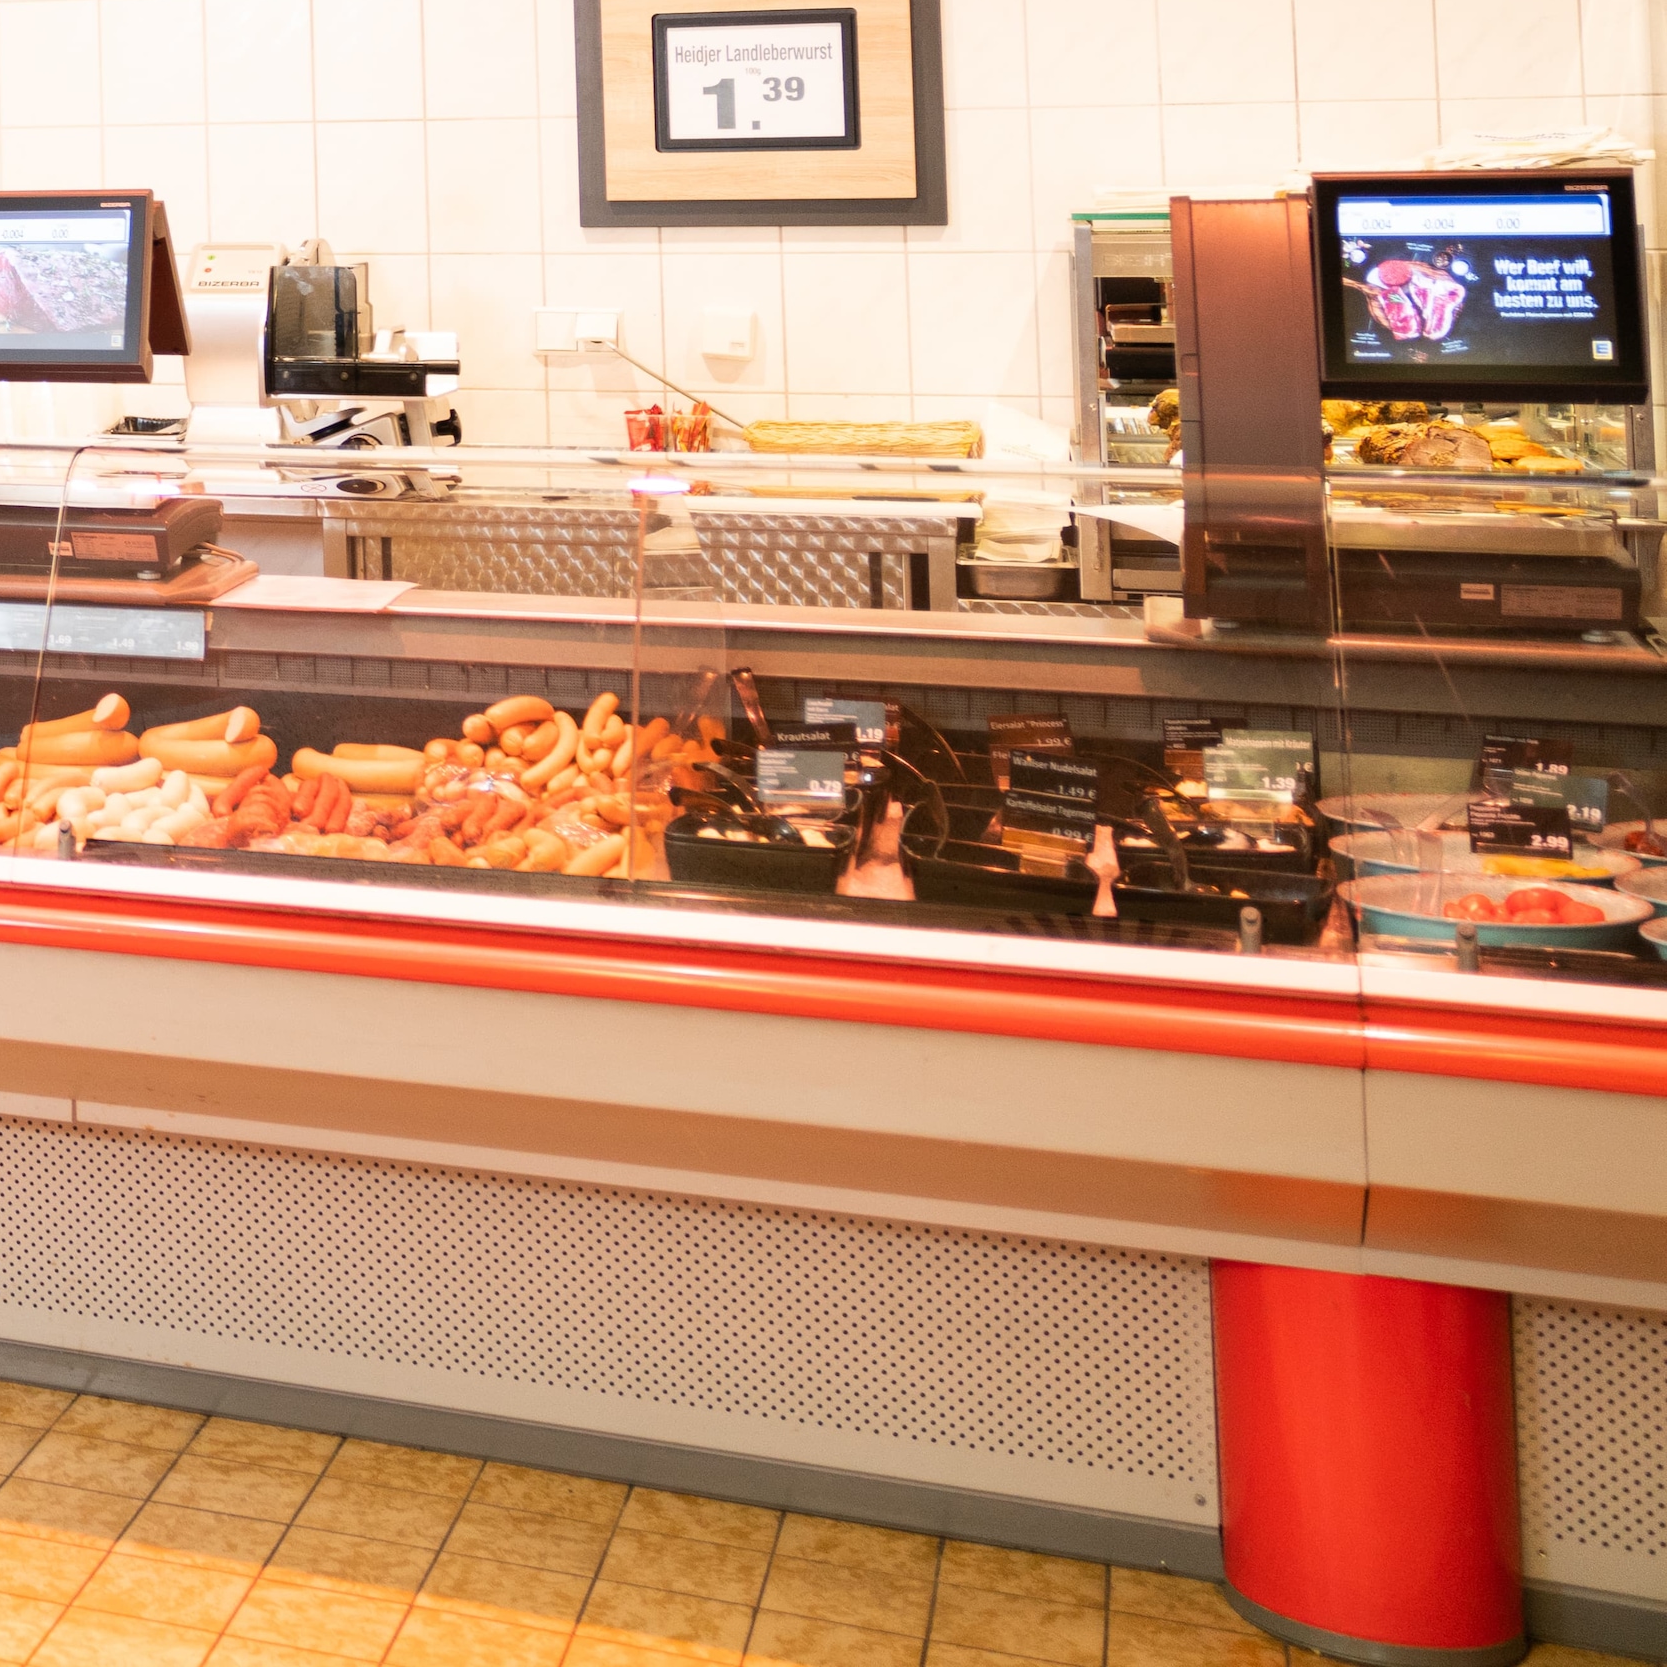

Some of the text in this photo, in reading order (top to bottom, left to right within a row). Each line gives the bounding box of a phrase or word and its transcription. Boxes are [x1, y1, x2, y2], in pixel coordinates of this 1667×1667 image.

[675, 42, 833, 66] Heidjer Landleberwurst
[1493, 259, 1593, 277] Wer Beef will,
[1506, 276, 1583, 292] kommt am
[1493, 292, 1599, 308] besten zu uns.
[989, 722, 1025, 730] Eiersalat
[777, 731, 831, 743] Krautsalat
[1037, 737, 1061, 746] 199
[1535, 762, 1568, 775] 1.89
[809, 780, 842, 792] 0.79
[1261, 776, 1296, 790] 1.39
[1088, 789, 1097, 800] €
[1531, 834, 1568, 848] 2.99
